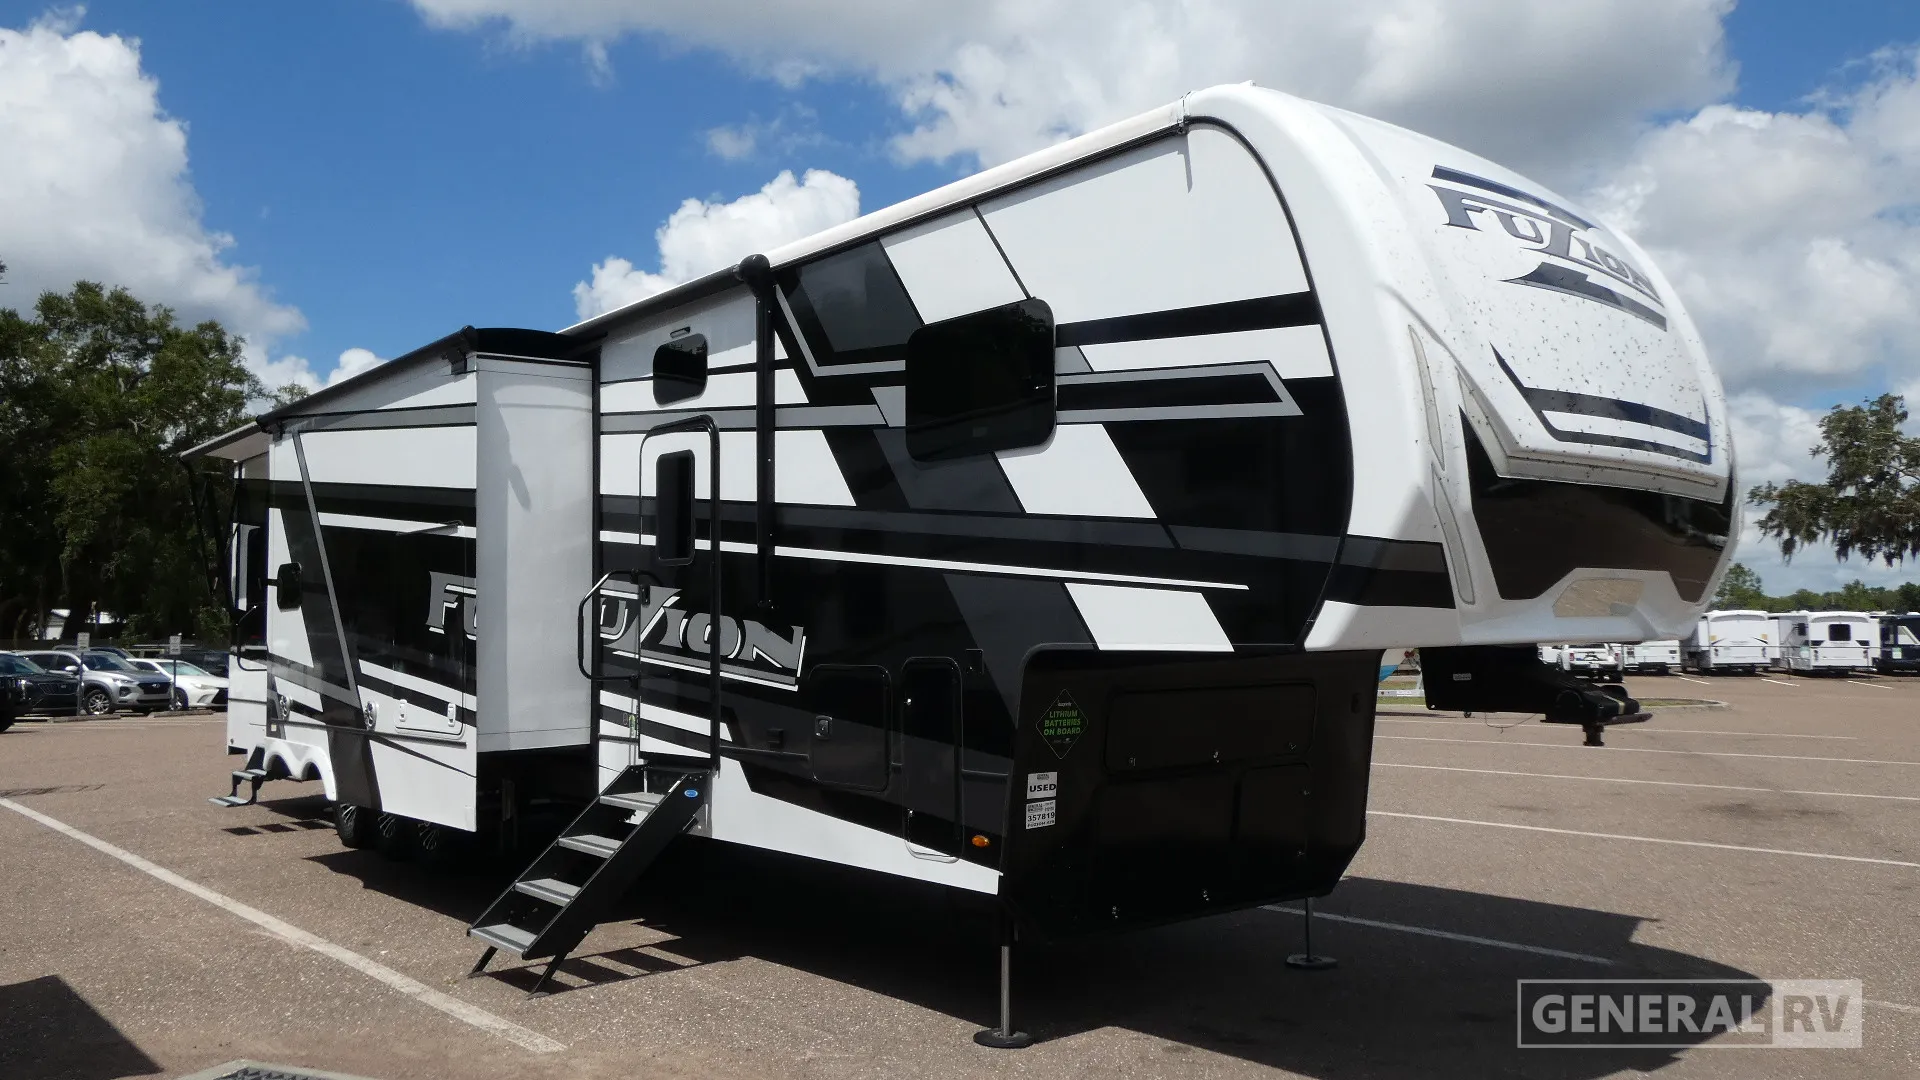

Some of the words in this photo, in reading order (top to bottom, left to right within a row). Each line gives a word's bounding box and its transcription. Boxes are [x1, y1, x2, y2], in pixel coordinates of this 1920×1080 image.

[1050, 709, 1078, 719] LITHIUM
[1044, 718, 1081, 728] BATTERIES
[1043, 728, 1055, 736] ON
[1057, 726, 1081, 736] BOARD
[1029, 783, 1056, 792] USED
[1027, 811, 1055, 822] 357819
